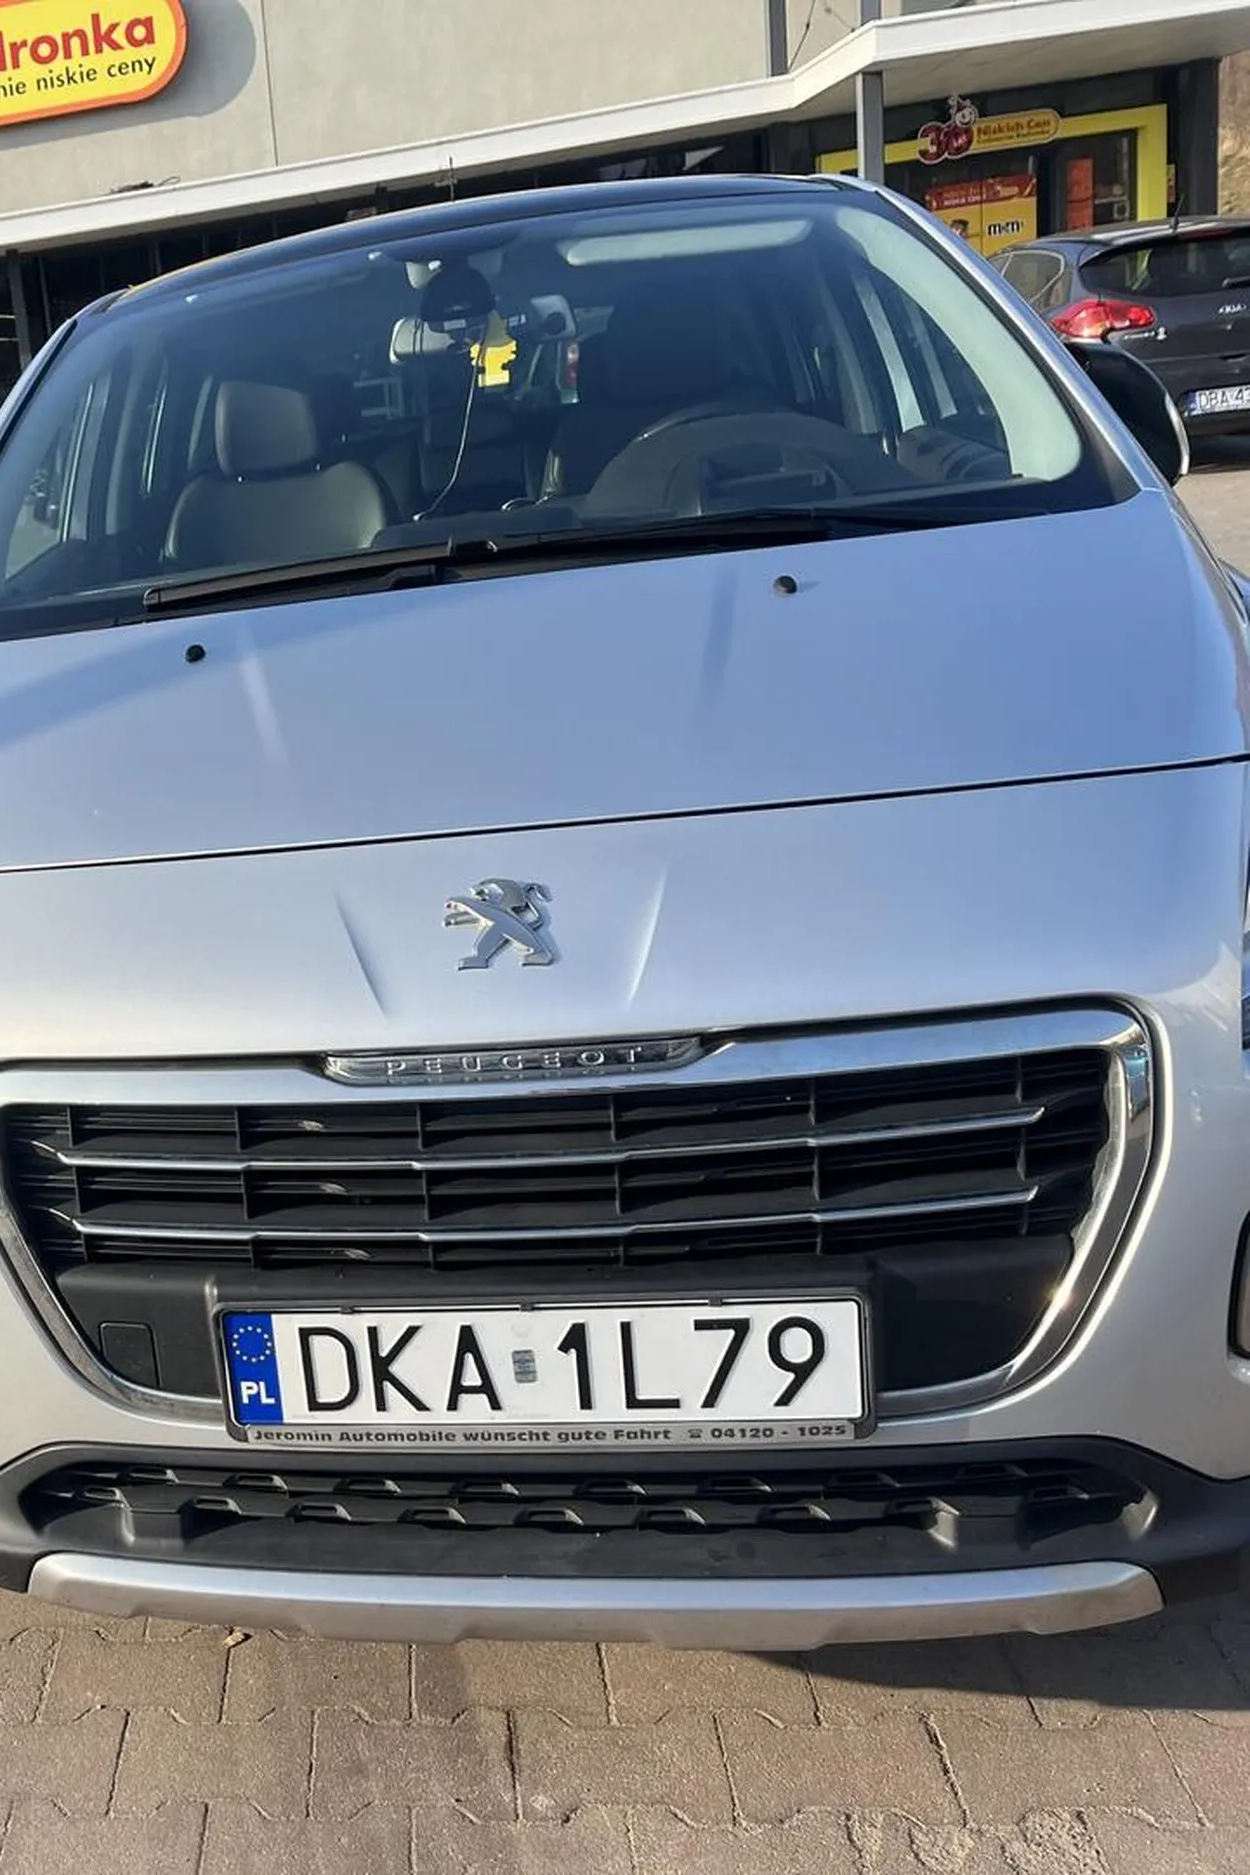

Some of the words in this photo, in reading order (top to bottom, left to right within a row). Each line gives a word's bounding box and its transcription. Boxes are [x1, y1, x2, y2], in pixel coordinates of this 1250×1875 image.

[36, 64, 98, 92] niskie
[107, 56, 157, 78] ceny
[385, 1046, 642, 1076] PEUGEOT
[298, 1324, 503, 1412] DKA
[557, 1315, 826, 1411] 1L79
[240, 1381, 275, 1405] PL
[253, 1429, 333, 1443] Jeromin
[338, 1429, 457, 1443] Automobile
[462, 1429, 550, 1443] wünscht
[557, 1428, 607, 1443] gute
[613, 1428, 672, 1441] Fahrt
[711, 1427, 774, 1440] 04120
[799, 1425, 847, 1438] 1025
